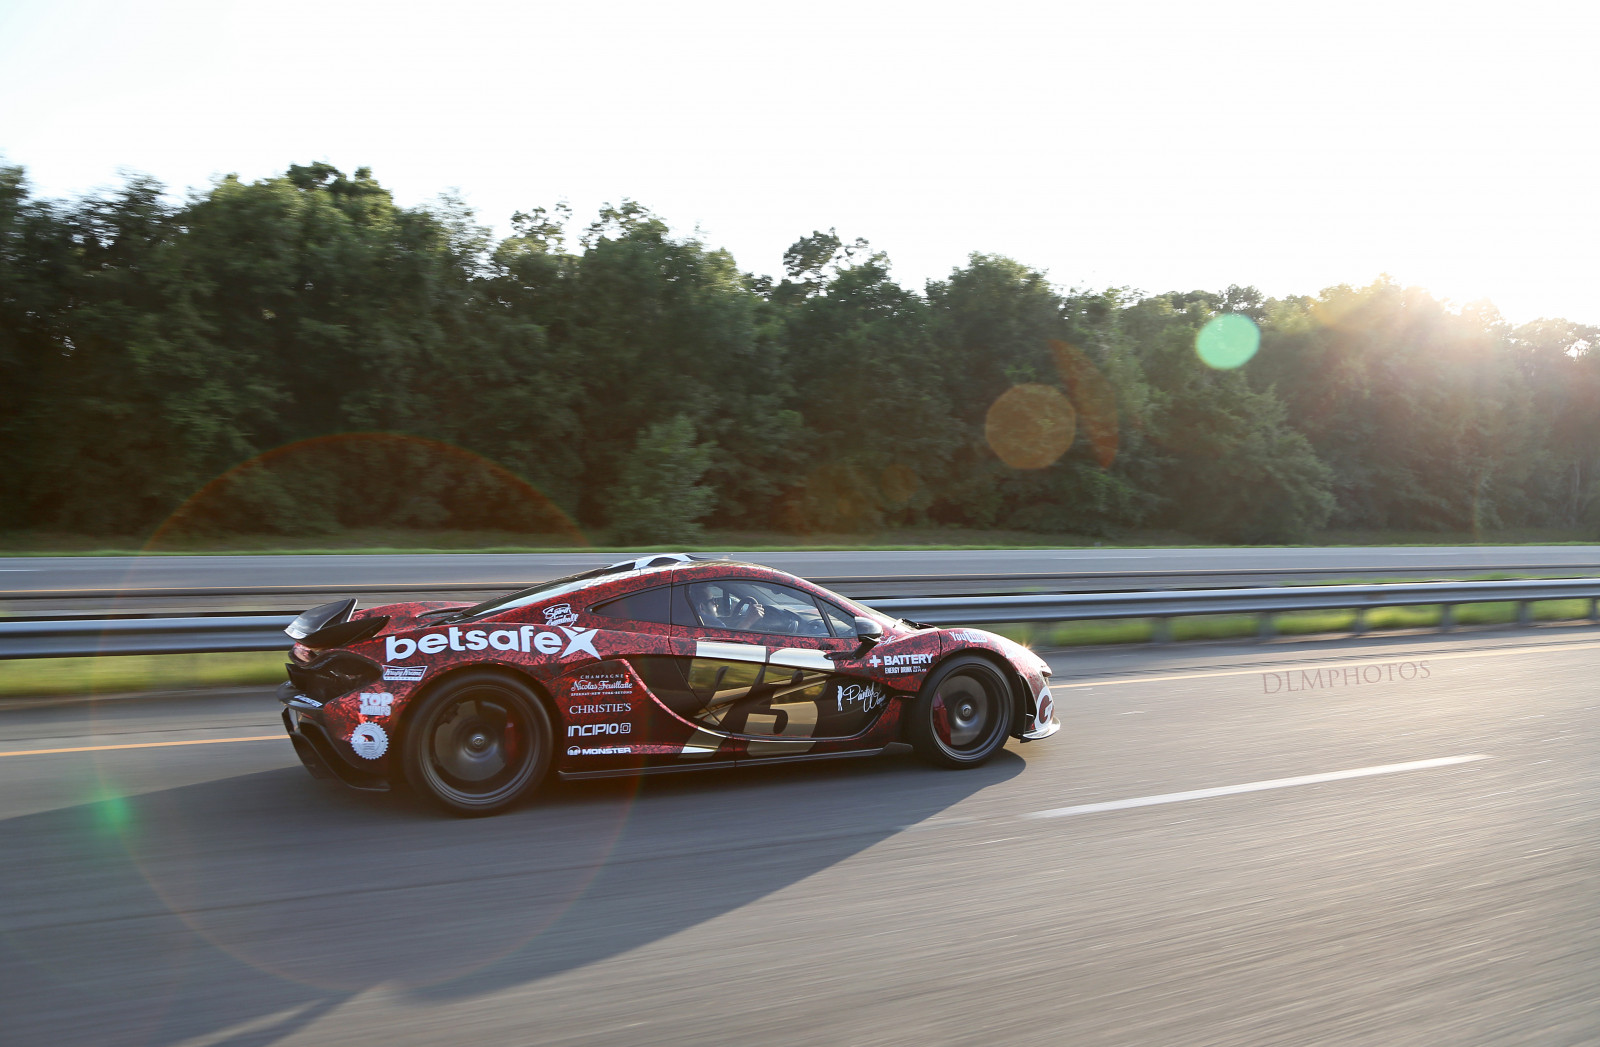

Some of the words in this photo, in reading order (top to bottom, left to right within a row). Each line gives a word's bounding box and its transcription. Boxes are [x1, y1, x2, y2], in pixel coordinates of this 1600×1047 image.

[883, 653, 933, 666] BATTERY
[360, 692, 394, 706] TOP
[569, 702, 632, 715] CHRISTIE'S
[567, 723, 619, 737] INCIPIO
[582, 747, 632, 756] MONSTER
